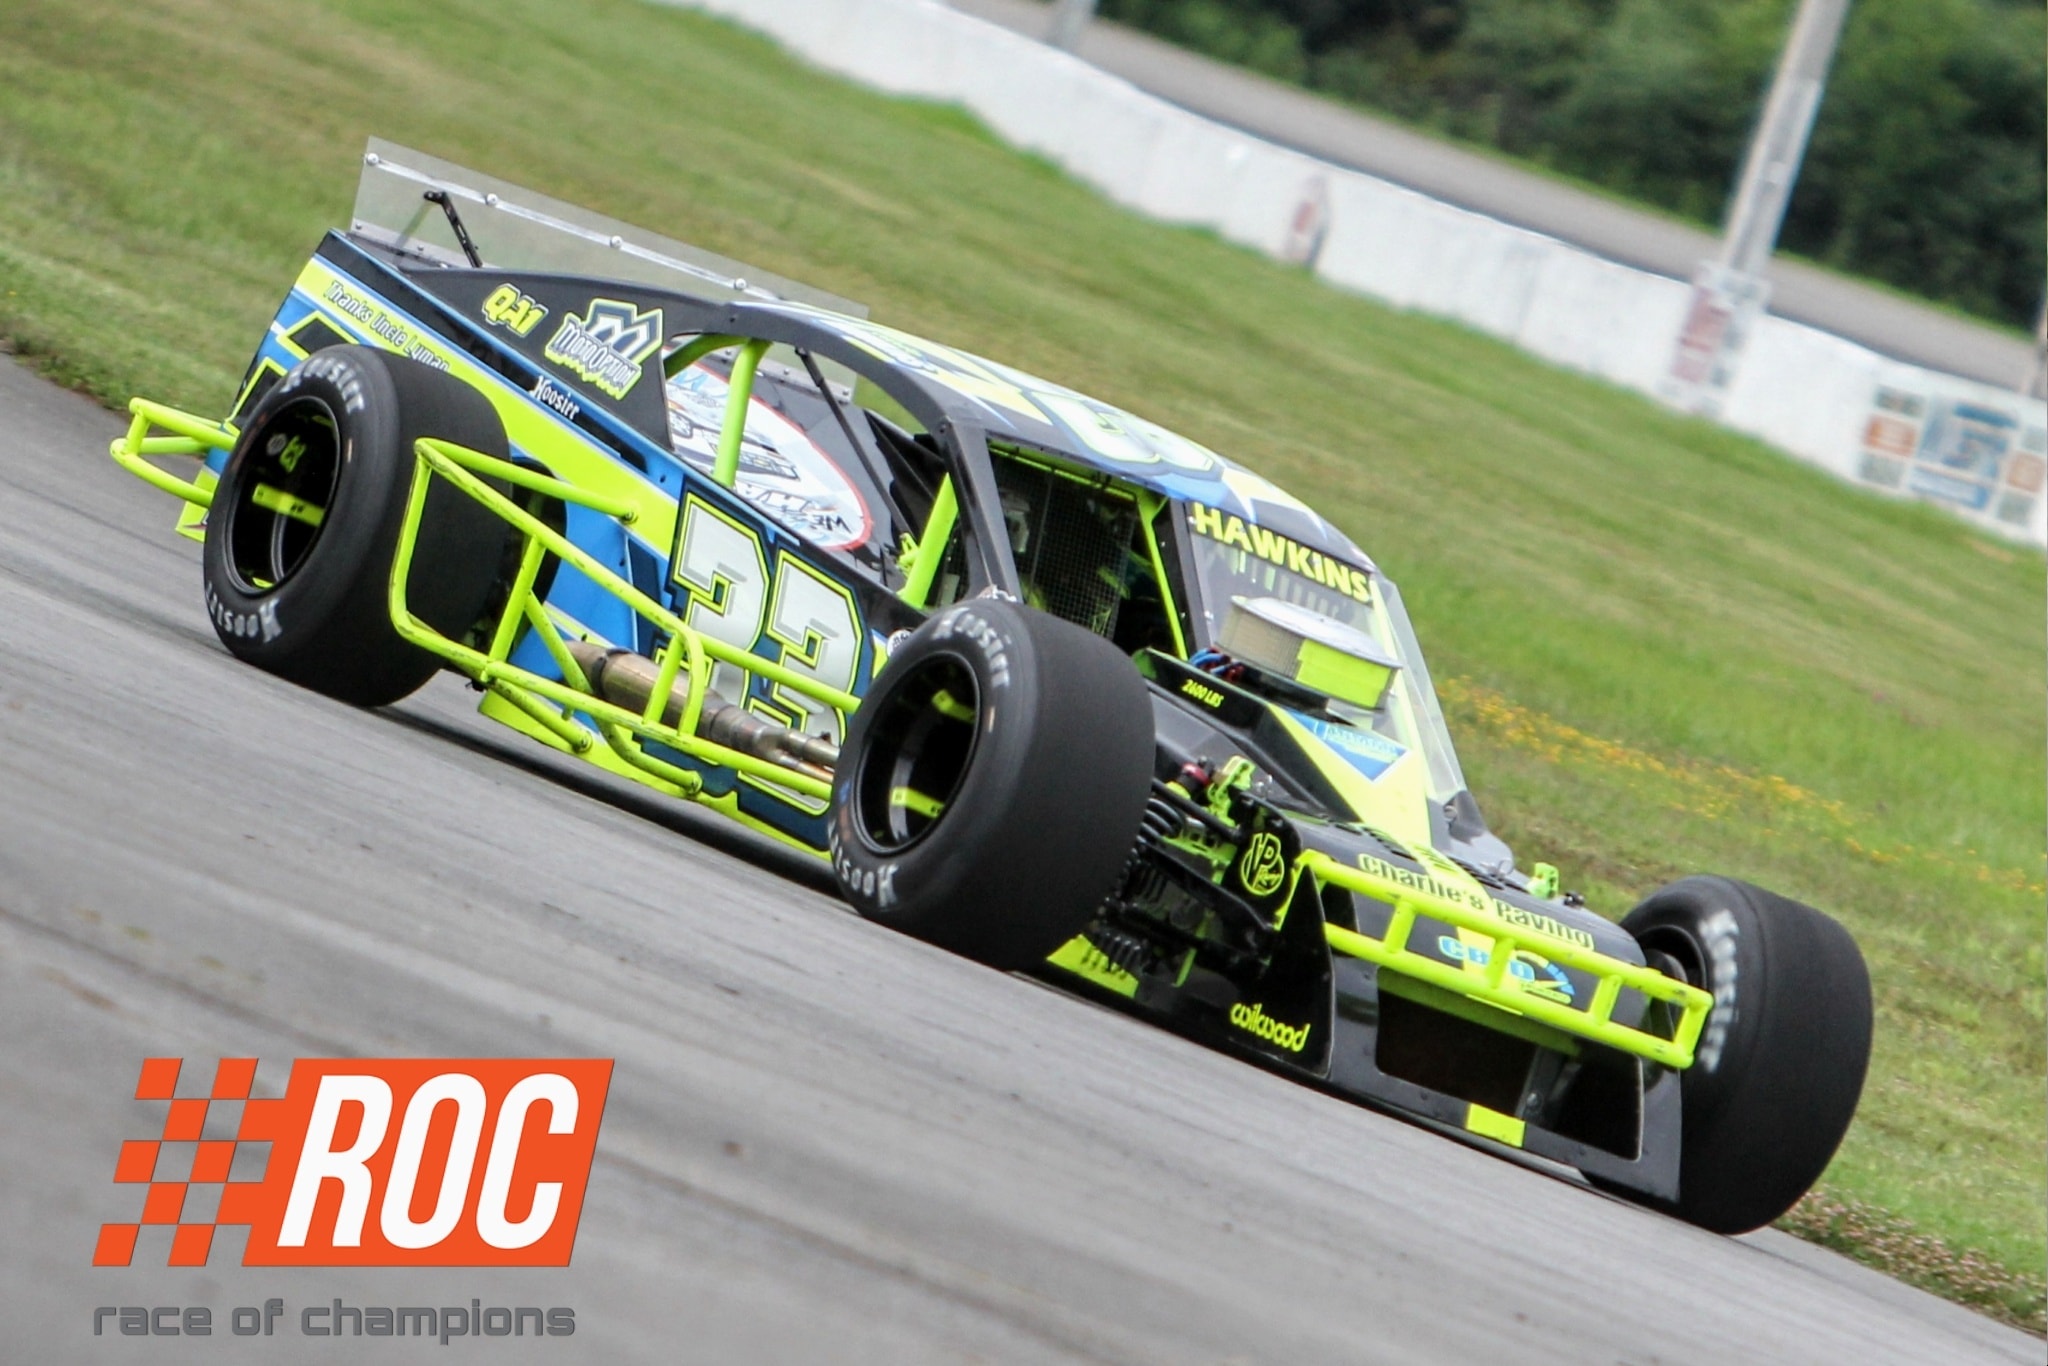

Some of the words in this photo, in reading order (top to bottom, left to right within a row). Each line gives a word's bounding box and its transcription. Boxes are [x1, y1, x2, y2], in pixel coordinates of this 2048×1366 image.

[323, 280, 374, 323] Thanks
[369, 311, 408, 347] Uncle
[481, 283, 549, 338] QA1
[528, 375, 580, 420] Hoosier
[1194, 502, 1371, 604] HAWKINS
[654, 490, 863, 817] 33
[1358, 853, 1486, 912] Charlie's
[1230, 1002, 1312, 1053] wilwood
